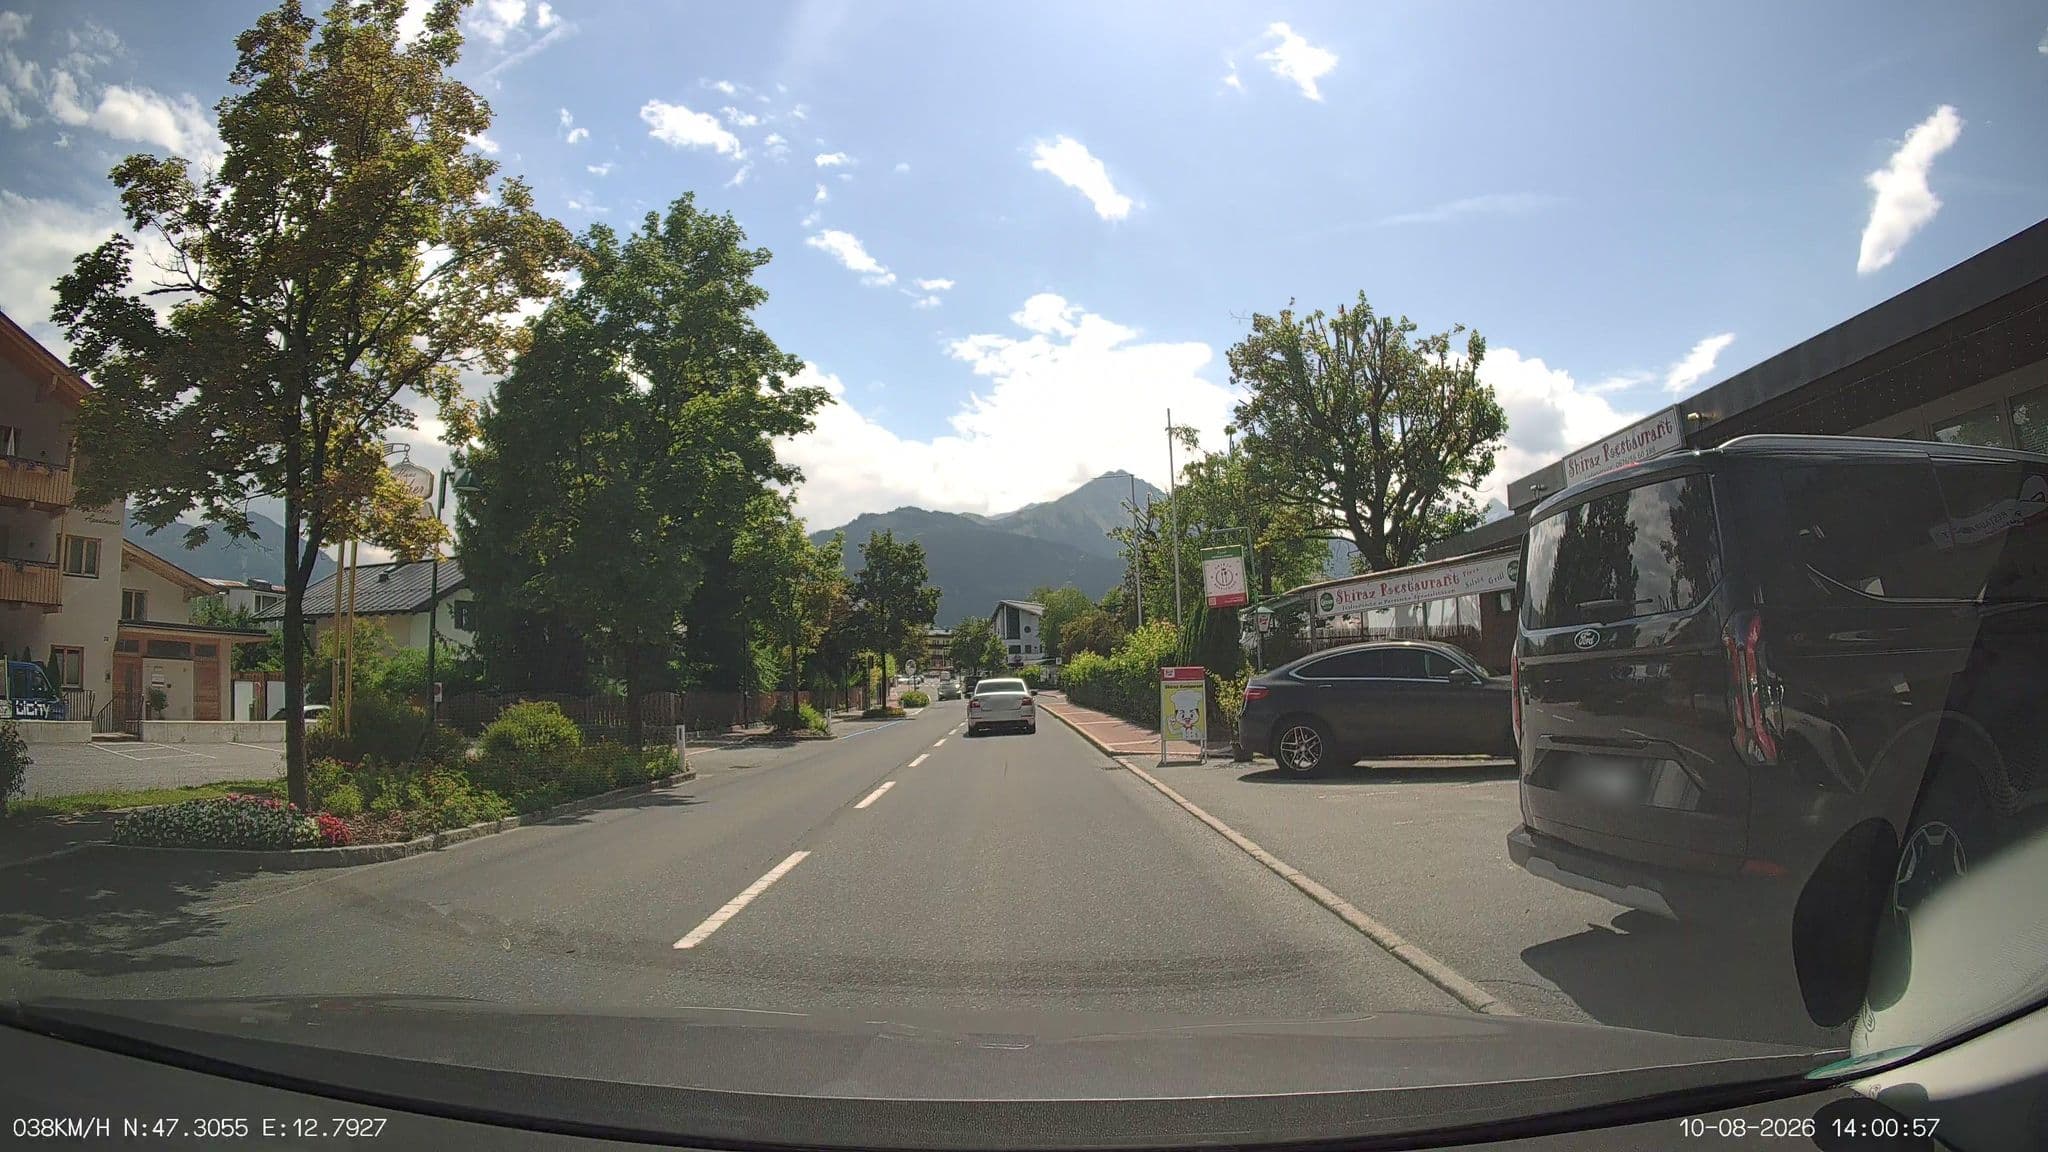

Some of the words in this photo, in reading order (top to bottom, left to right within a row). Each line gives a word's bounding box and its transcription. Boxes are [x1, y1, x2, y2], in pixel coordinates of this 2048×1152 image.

[1568, 455, 1600, 477] Shiraz
[1602, 418, 1674, 462] Restaurant
[1335, 588, 1377, 605] Shiraz
[1380, 573, 1460, 598] Restaurant
